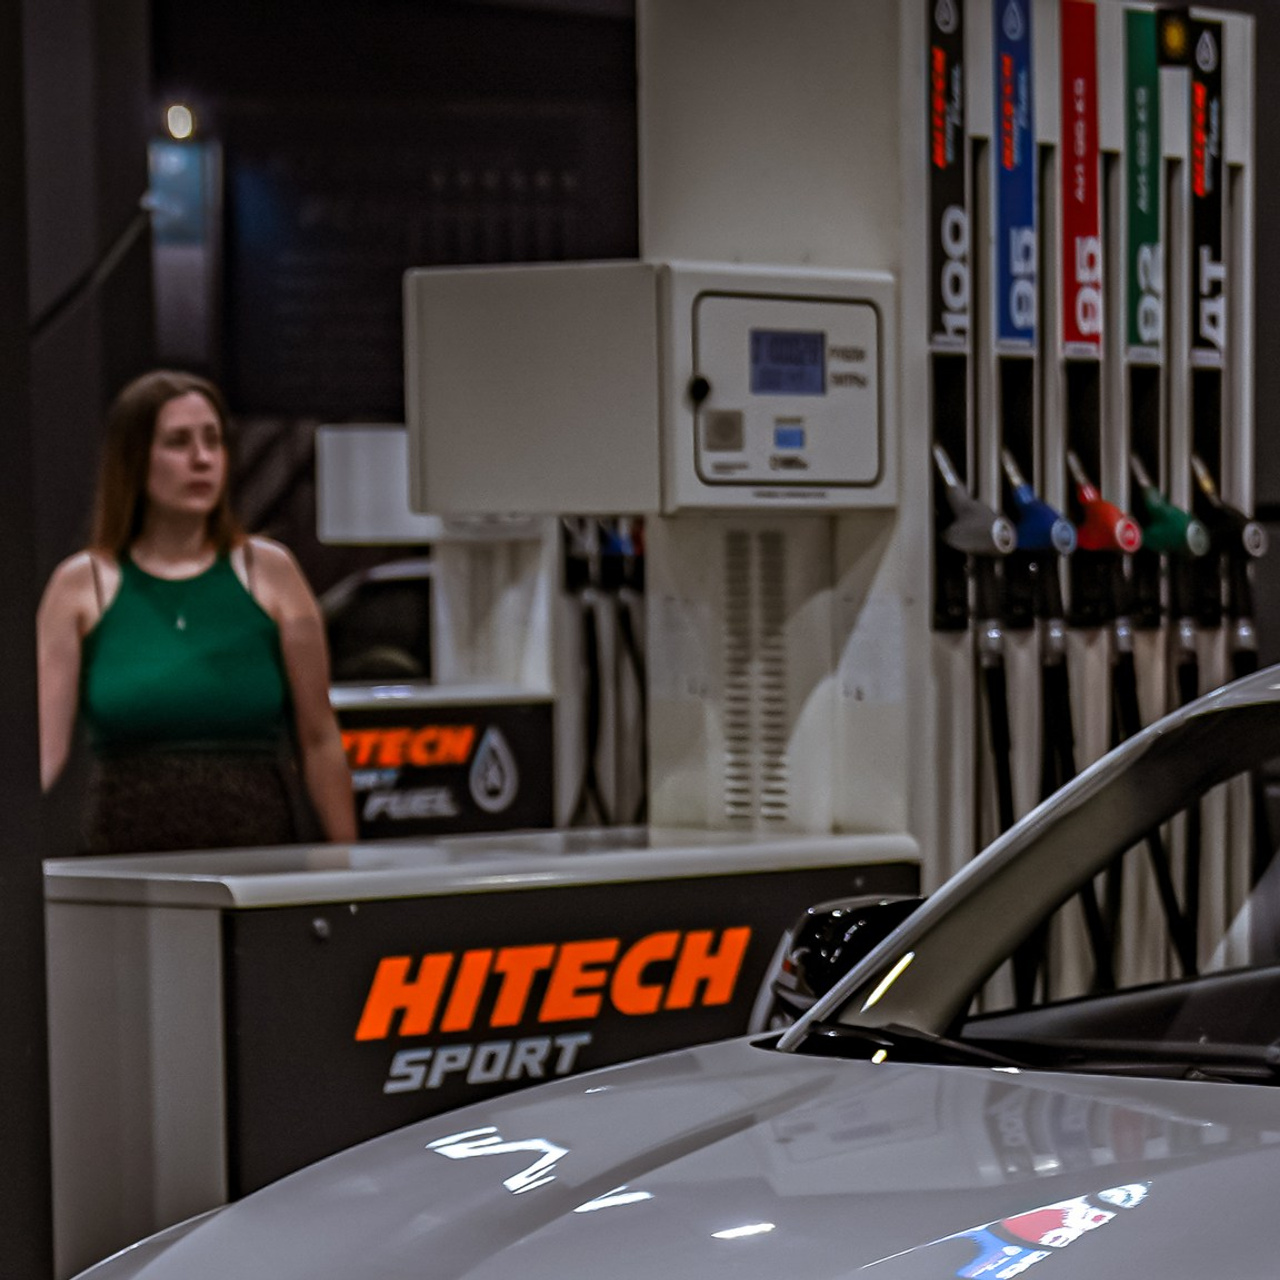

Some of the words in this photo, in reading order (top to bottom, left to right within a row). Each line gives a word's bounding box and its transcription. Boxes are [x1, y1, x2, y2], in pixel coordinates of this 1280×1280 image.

[1074, 236, 1102, 336] 95
[1136, 242, 1163, 343] 92
[354, 926, 752, 1041] HITECH
[383, 1032, 593, 1094] SPORT
